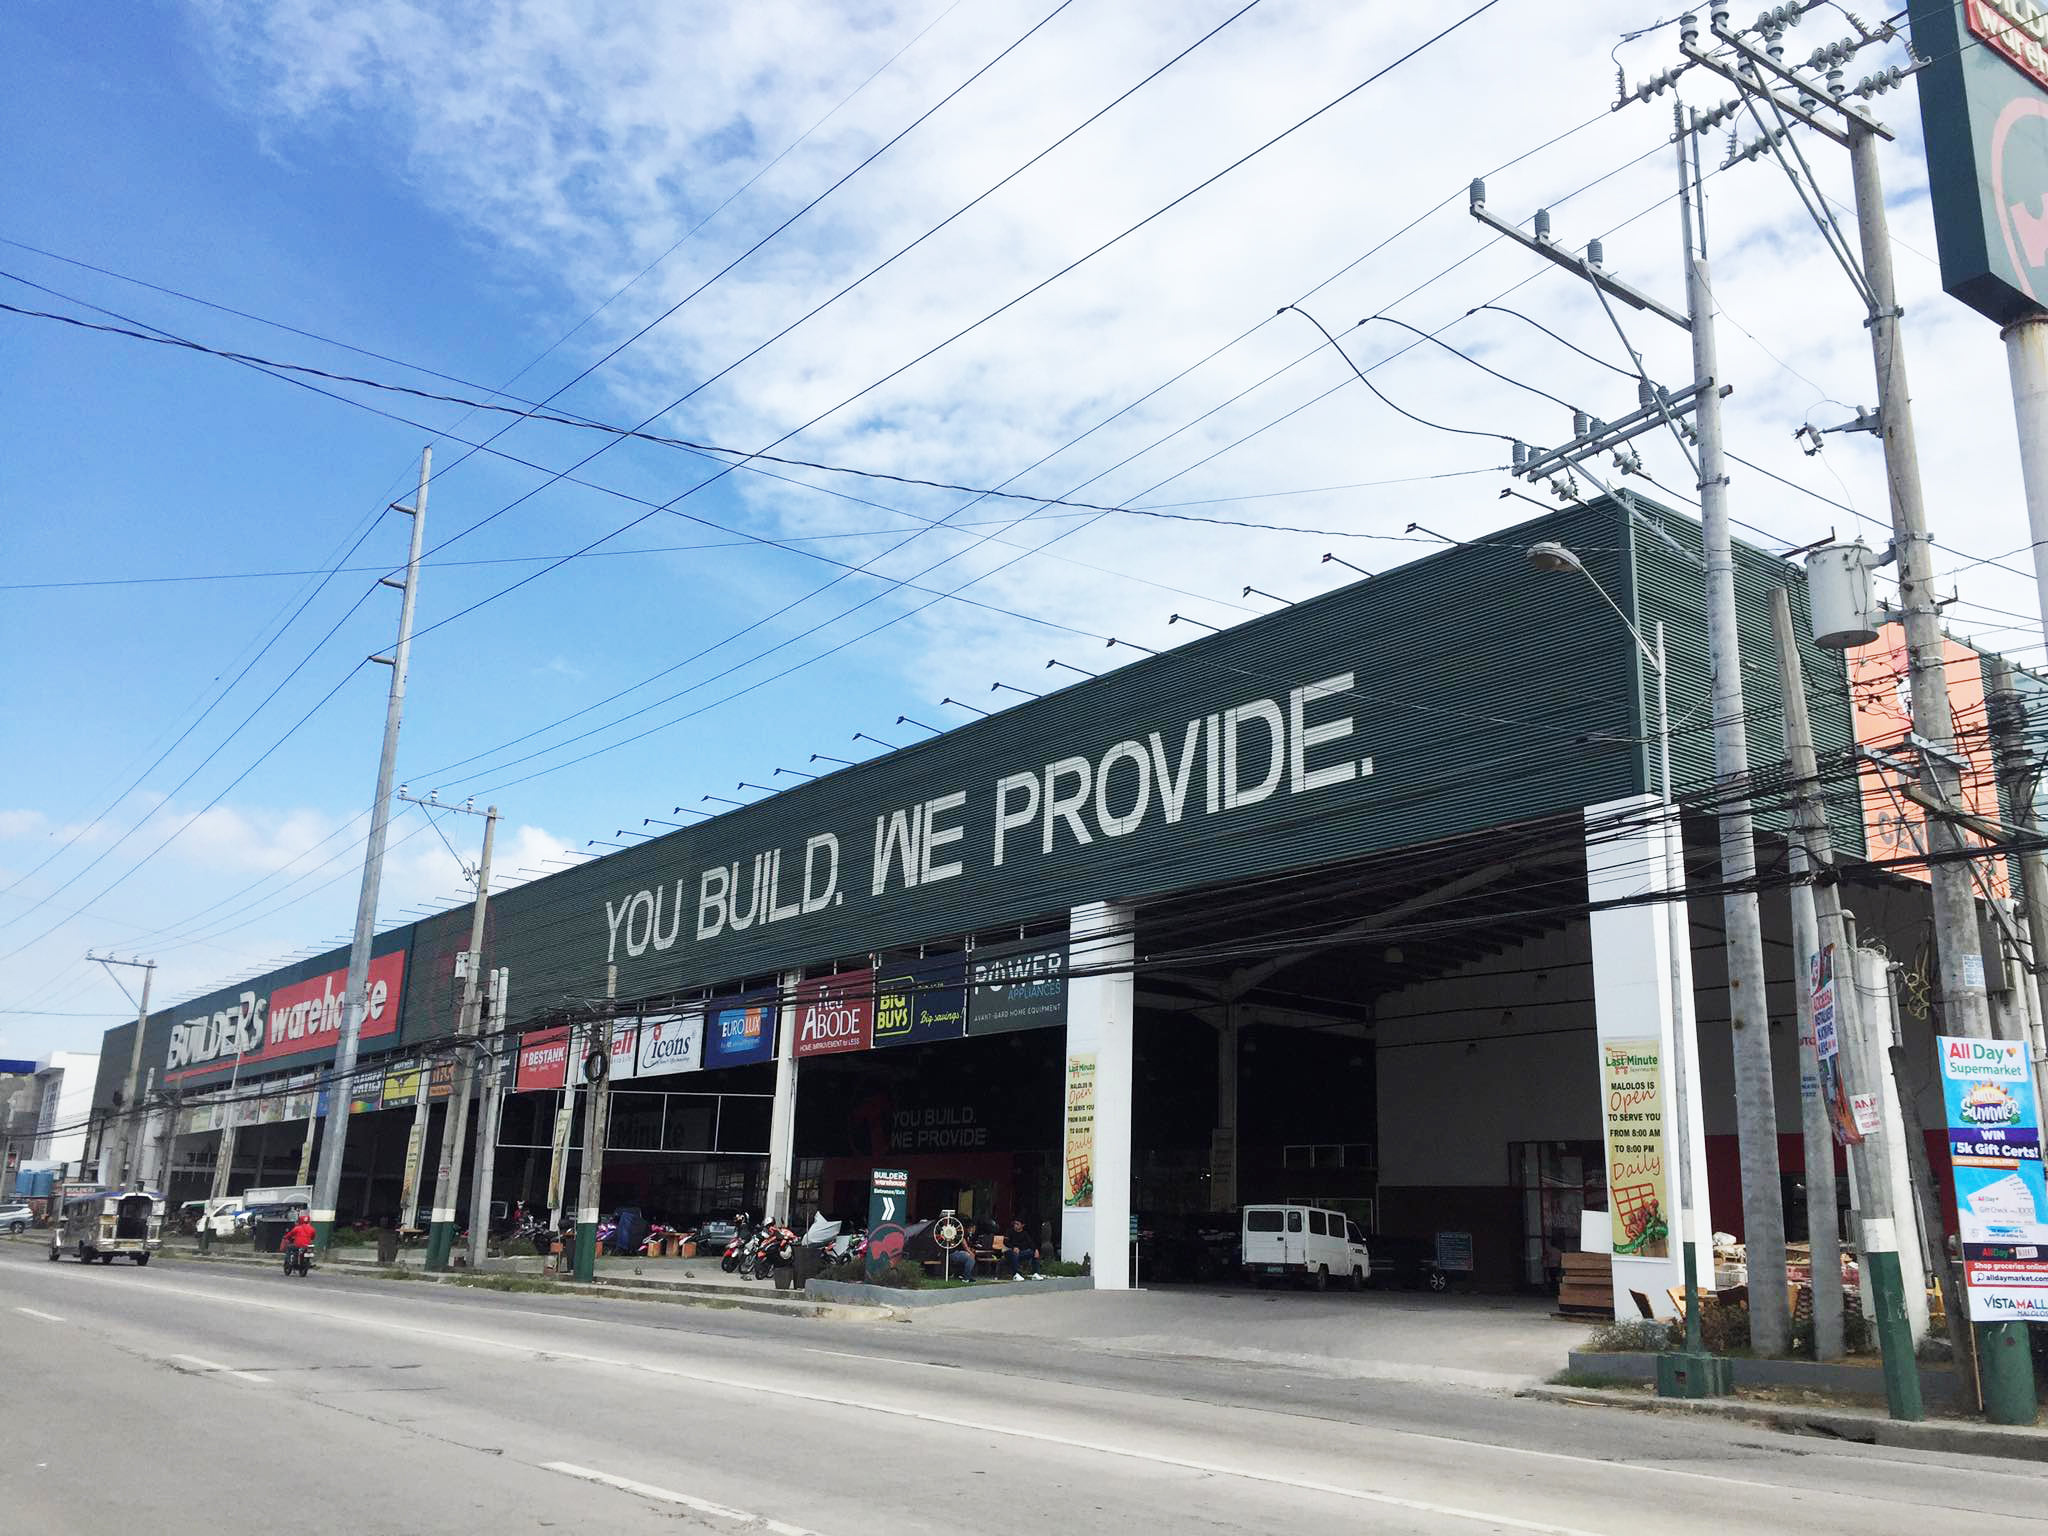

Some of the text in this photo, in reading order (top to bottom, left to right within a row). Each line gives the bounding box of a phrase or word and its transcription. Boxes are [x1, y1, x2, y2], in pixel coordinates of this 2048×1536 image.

[605, 671, 1373, 962] YOU BUILD. WE PROVIDE.
[974, 953, 1062, 995] POWER
[1008, 982, 1061, 1000] APPLIANCES
[801, 1006, 861, 1041] ABODE
[877, 1008, 908, 1030] BUYS
[920, 1010, 933, 1028] Big
[652, 1035, 690, 1059] icons
[528, 1046, 564, 1067] BESTANK
[1606, 1055, 1658, 1067] Last Minute
[1950, 1062, 2022, 1077] Supermarket
[1611, 1081, 1655, 1091] MALOLOS IS
[1610, 1090, 1656, 1112] Open
[893, 1110, 920, 1127] YOU
[1608, 1113, 1661, 1121] TO SERVE YOU
[891, 1131, 912, 1148] WE
[1610, 1129, 1661, 1137] FROM 8:00 AM
[1981, 1130, 2006, 1141] WIN
[1615, 1145, 1655, 1153] TO 8:00 PM
[1956, 1142, 2039, 1158] 5k Gift Certs!
[1613, 1153, 1660, 1181] Daily
